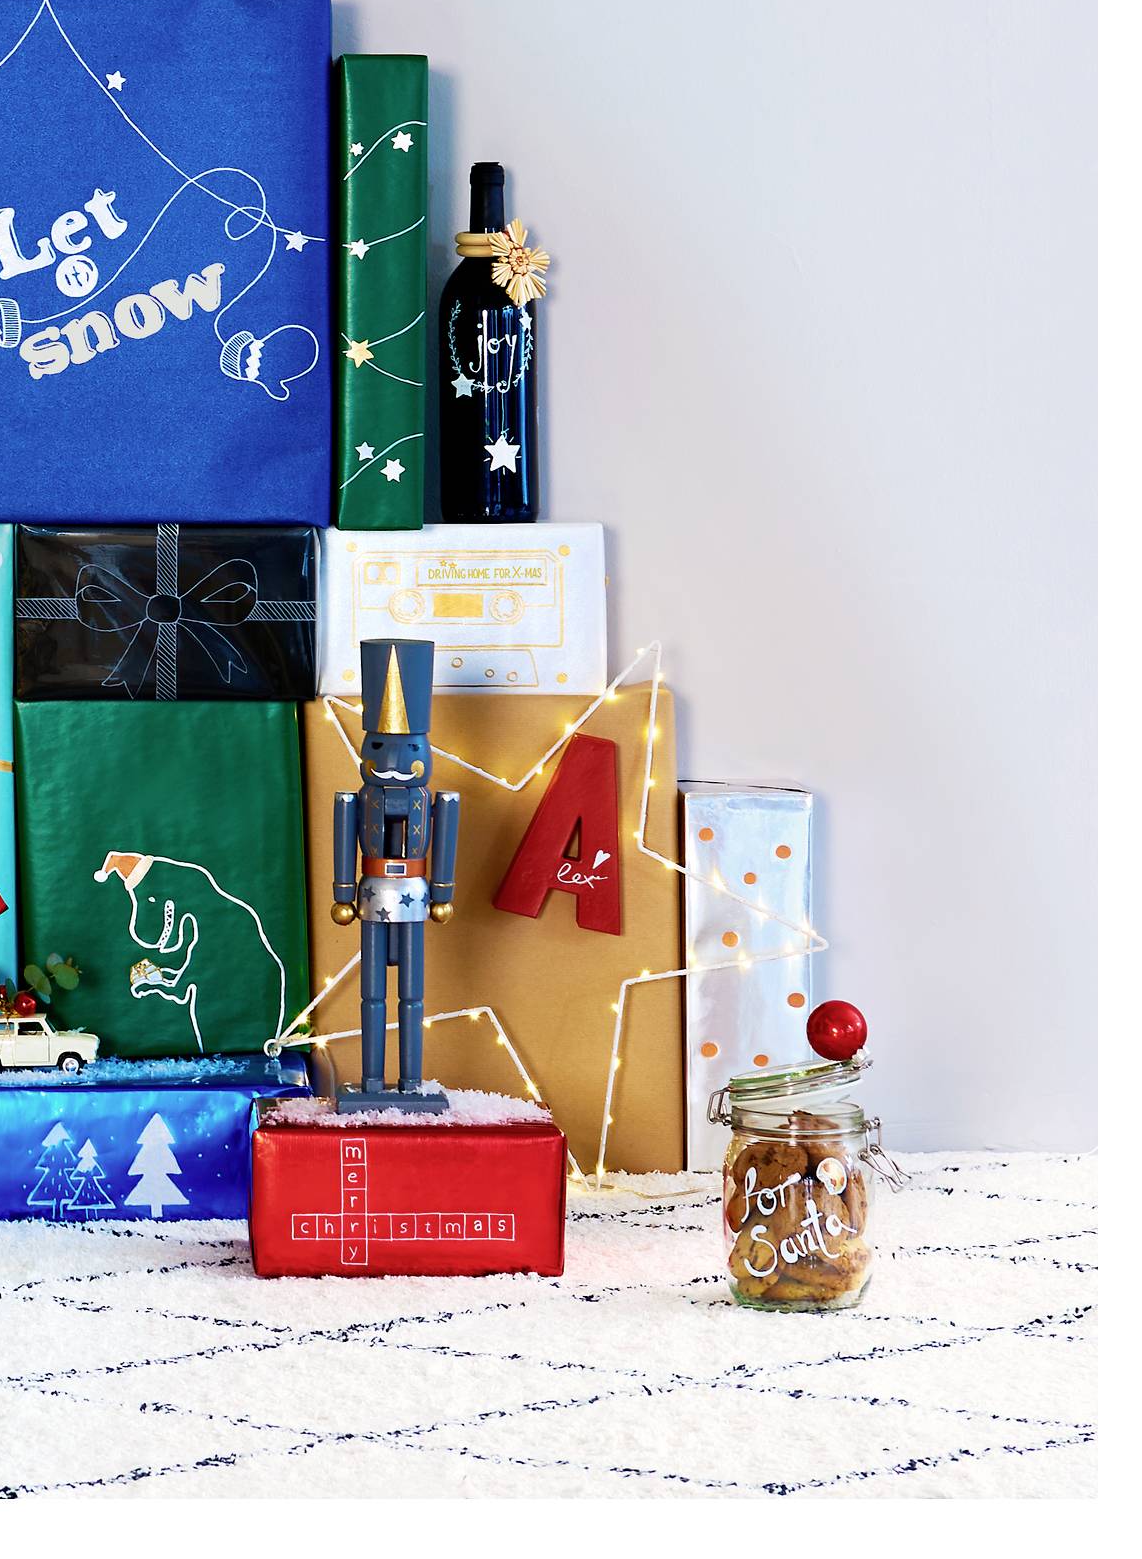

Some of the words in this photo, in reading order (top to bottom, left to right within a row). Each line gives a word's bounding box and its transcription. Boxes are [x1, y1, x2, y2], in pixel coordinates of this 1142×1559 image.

[19, 262, 225, 380] snow
[469, 322, 518, 394] joy
[428, 568, 466, 580] DRIVING
[467, 568, 491, 579] HOME
[493, 567, 511, 579] FOR
[512, 566, 542, 579] X-MAS
[492, 731, 622, 937] A
[299, 1218, 507, 1237] christmas
[345, 1144, 363, 1260] merry
[741, 1166, 802, 1224] for
[744, 1199, 858, 1278] Santa
